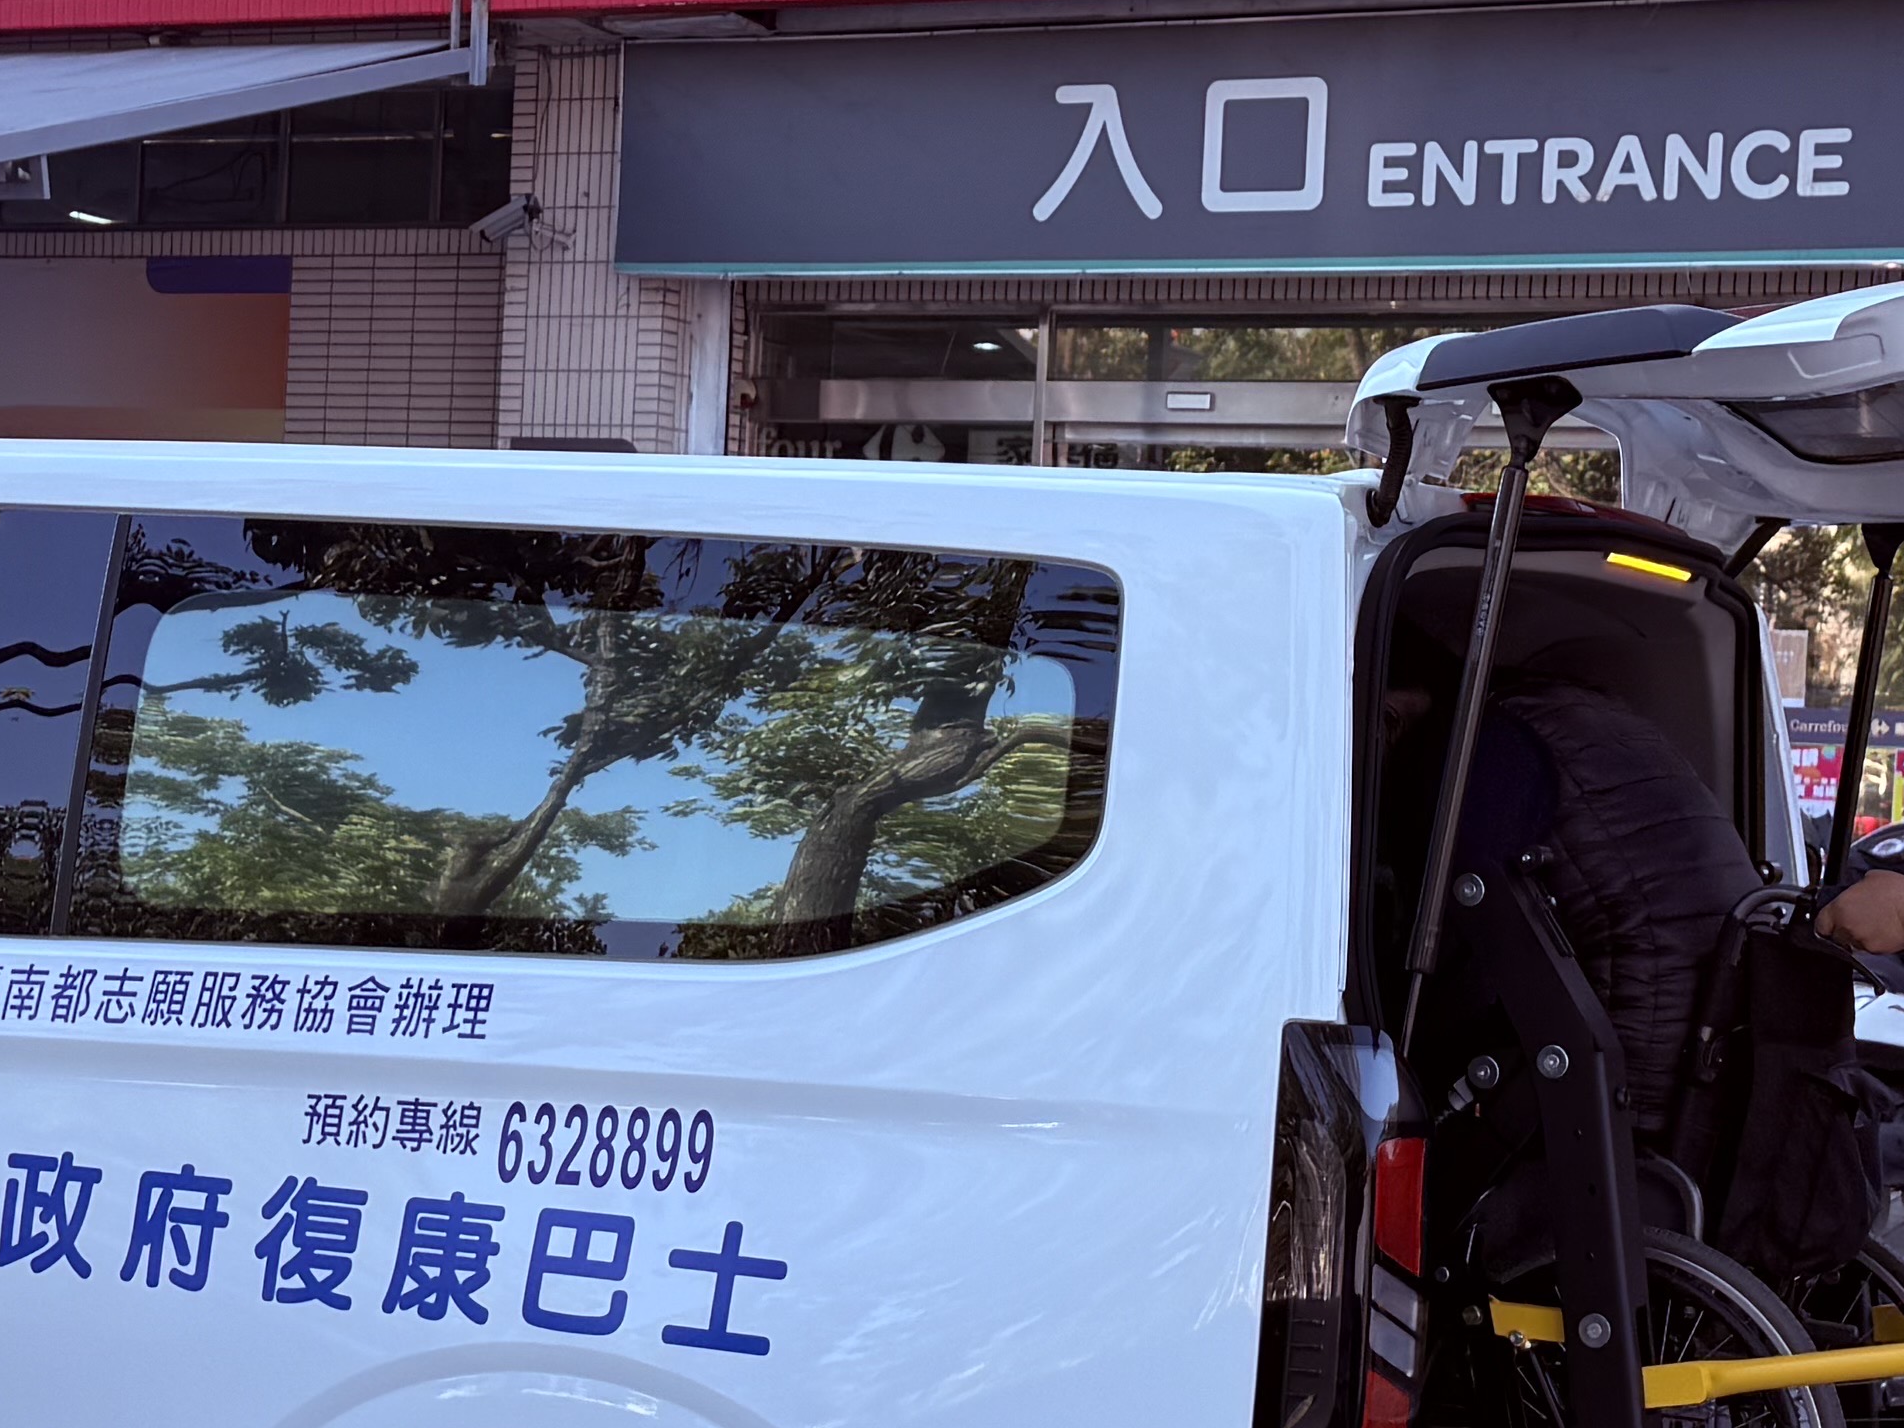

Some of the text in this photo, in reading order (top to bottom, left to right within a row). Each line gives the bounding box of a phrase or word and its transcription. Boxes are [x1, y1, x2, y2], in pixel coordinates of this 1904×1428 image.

[1030, 75, 1853, 223] 入口 ENTRANCE
[303, 1093, 717, 1195] 預約專線 6328899
